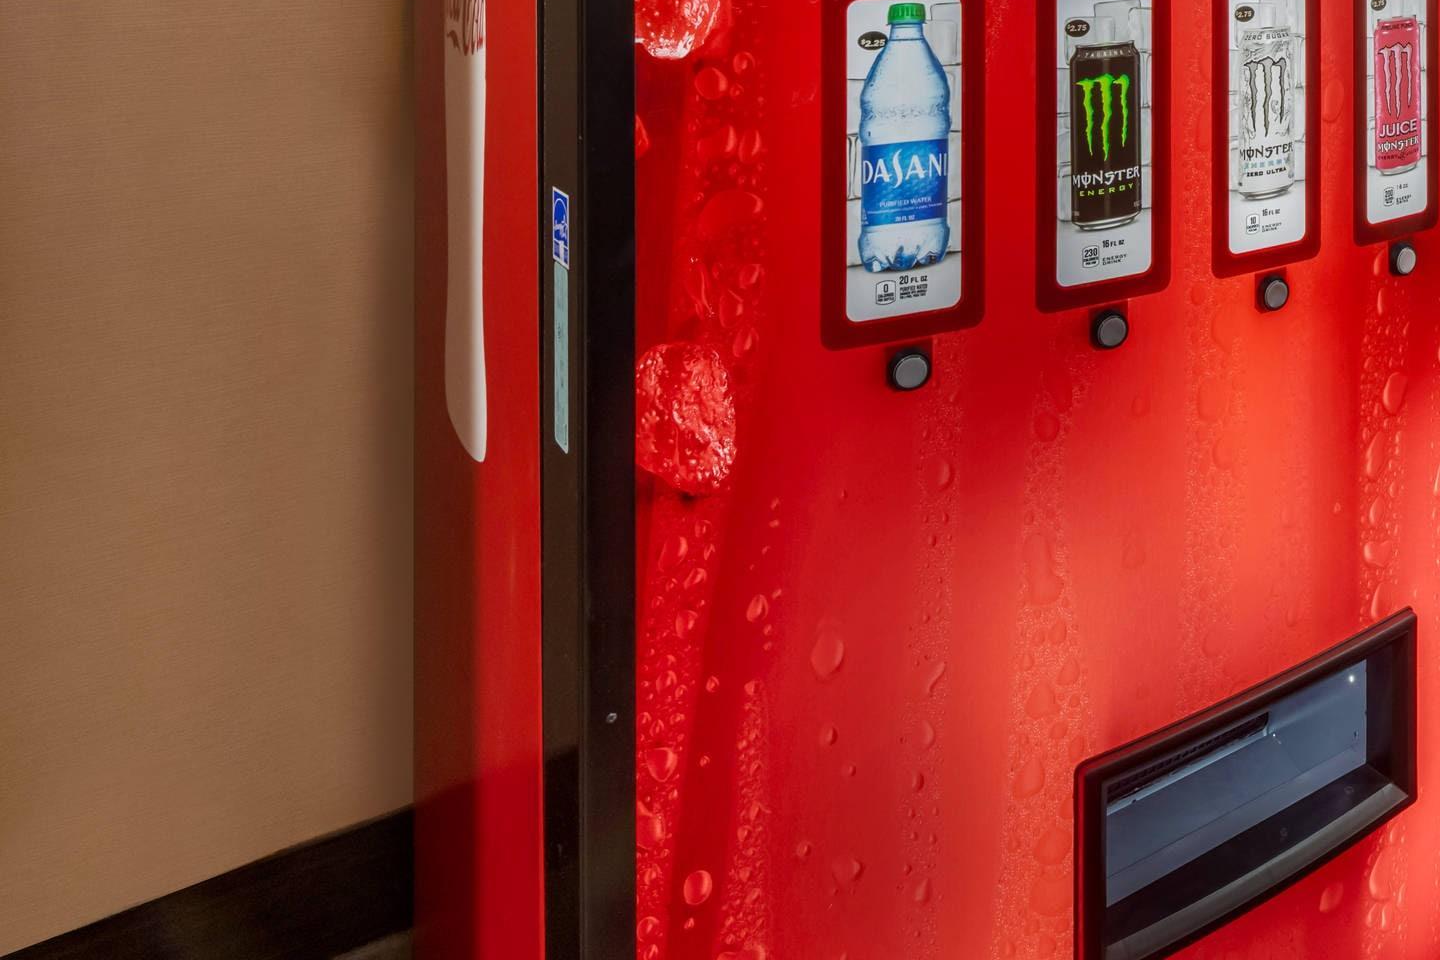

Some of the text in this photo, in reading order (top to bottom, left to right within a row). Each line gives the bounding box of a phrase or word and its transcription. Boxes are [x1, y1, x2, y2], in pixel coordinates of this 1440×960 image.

[1067, 24, 1088, 32] $2.75
[861, 39, 886, 48] $2.25
[1379, 118, 1417, 137] JUICE
[1240, 142, 1293, 161] MONSTER
[862, 148, 948, 189] DASANI
[1266, 166, 1287, 175] ULTRA
[1073, 165, 1140, 189] MONSTER
[1079, 182, 1134, 197] ENERGY
[1250, 216, 1257, 224] 10
[1084, 247, 1098, 258] 230
[899, 274, 909, 285] 20
[910, 276, 918, 284] FL
[883, 283, 889, 293] 0
